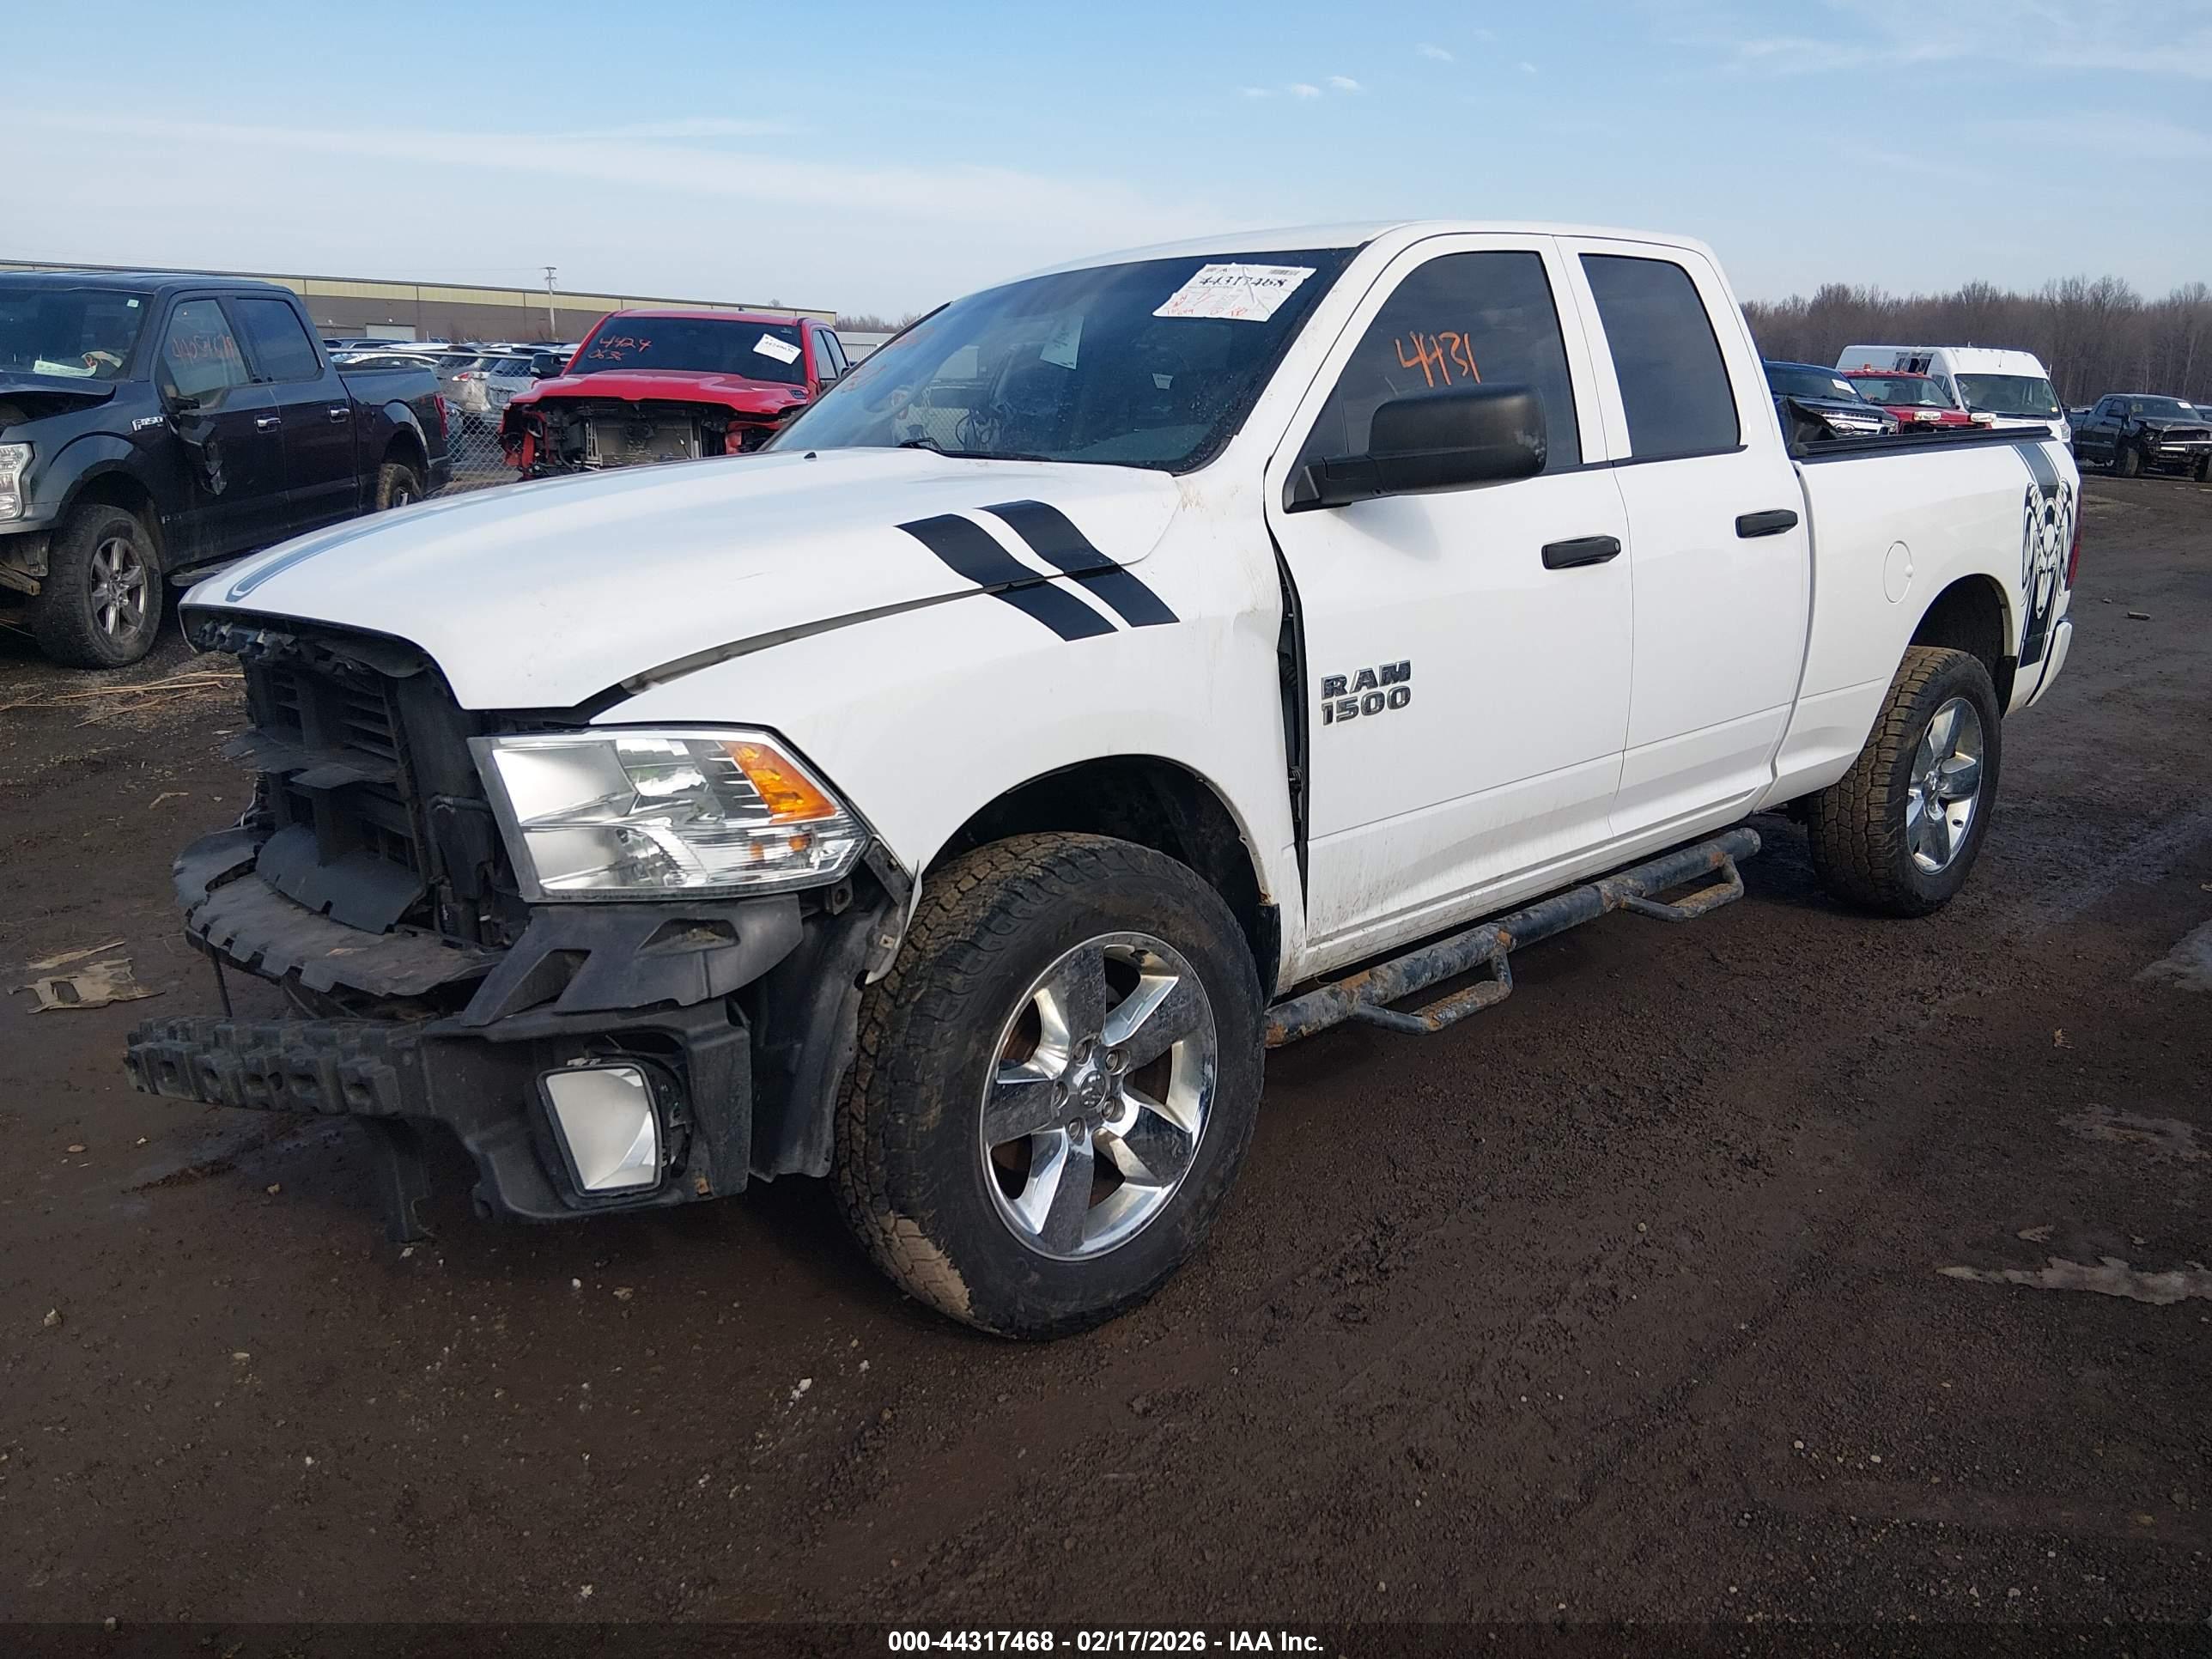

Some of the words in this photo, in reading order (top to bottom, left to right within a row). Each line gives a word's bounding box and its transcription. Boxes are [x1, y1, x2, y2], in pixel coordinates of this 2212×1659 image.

[1395, 330, 1482, 388] 4431
[1321, 659, 1412, 700] RAM
[1321, 685, 1412, 726] 1500
